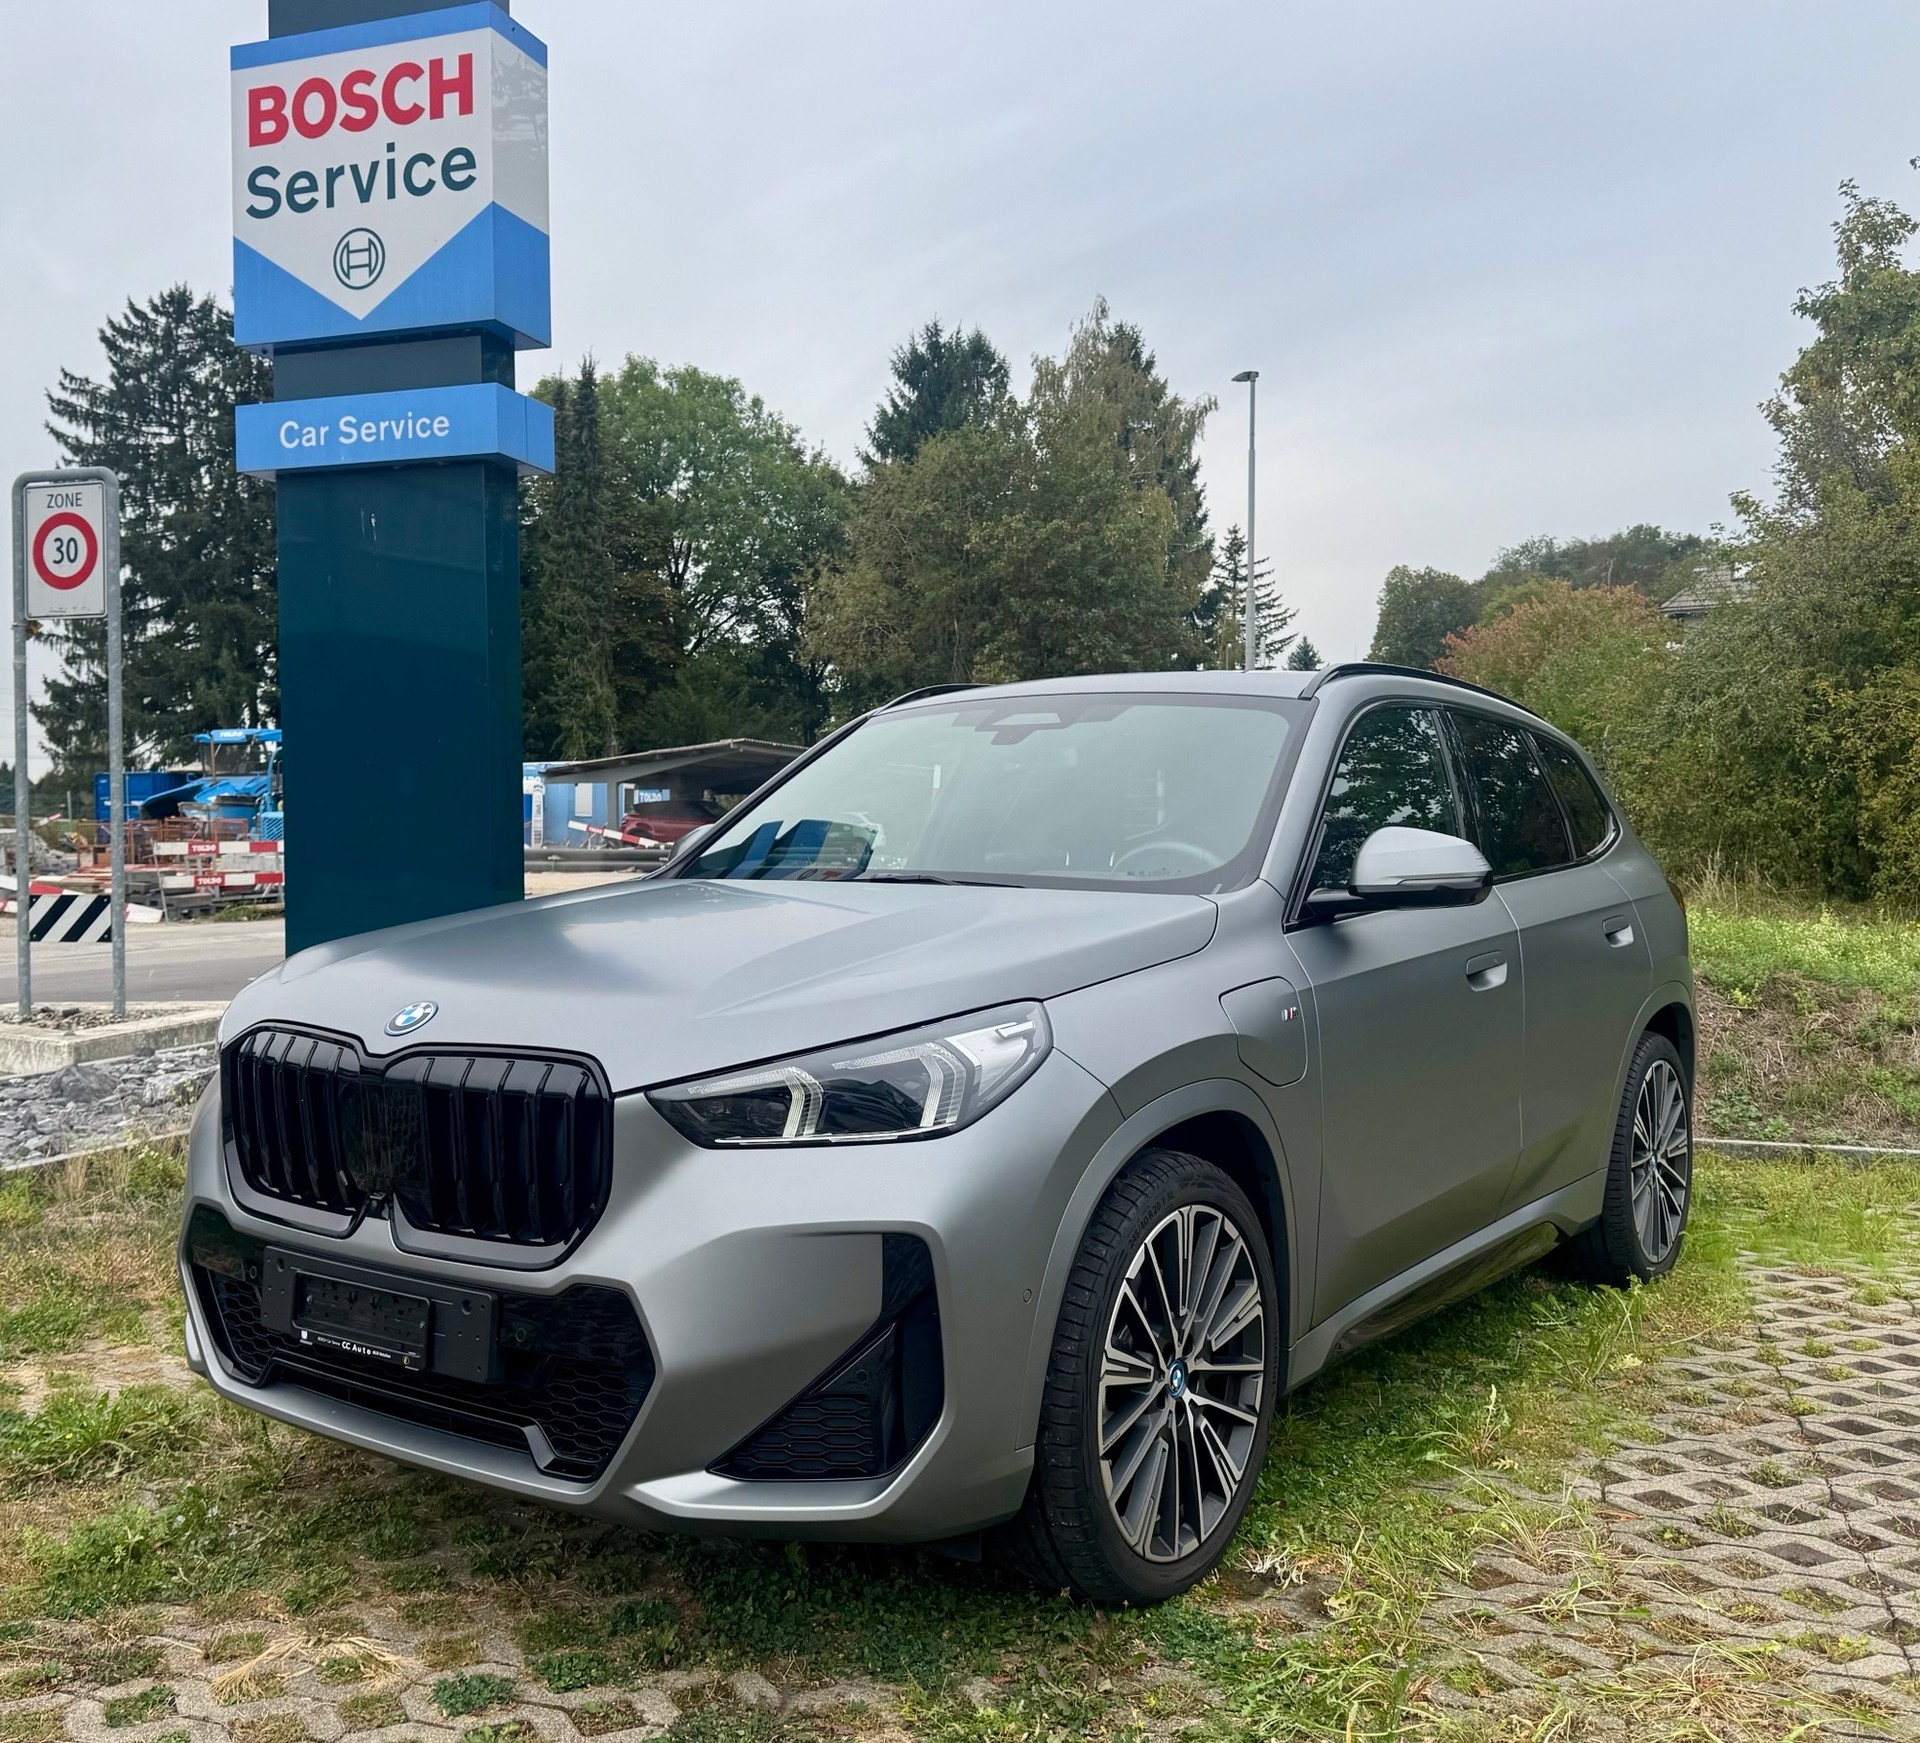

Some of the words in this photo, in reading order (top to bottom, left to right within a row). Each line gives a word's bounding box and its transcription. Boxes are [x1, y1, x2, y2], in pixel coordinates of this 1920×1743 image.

[247, 52, 474, 148] BOSCH
[245, 141, 477, 219] Service
[279, 420, 329, 449] Car
[338, 411, 450, 445] Service
[46, 492, 83, 509] ZONE
[52, 537, 78, 564] 30
[639, 792, 662, 803] TOLDO
[352, 1344, 372, 1355] Auto
